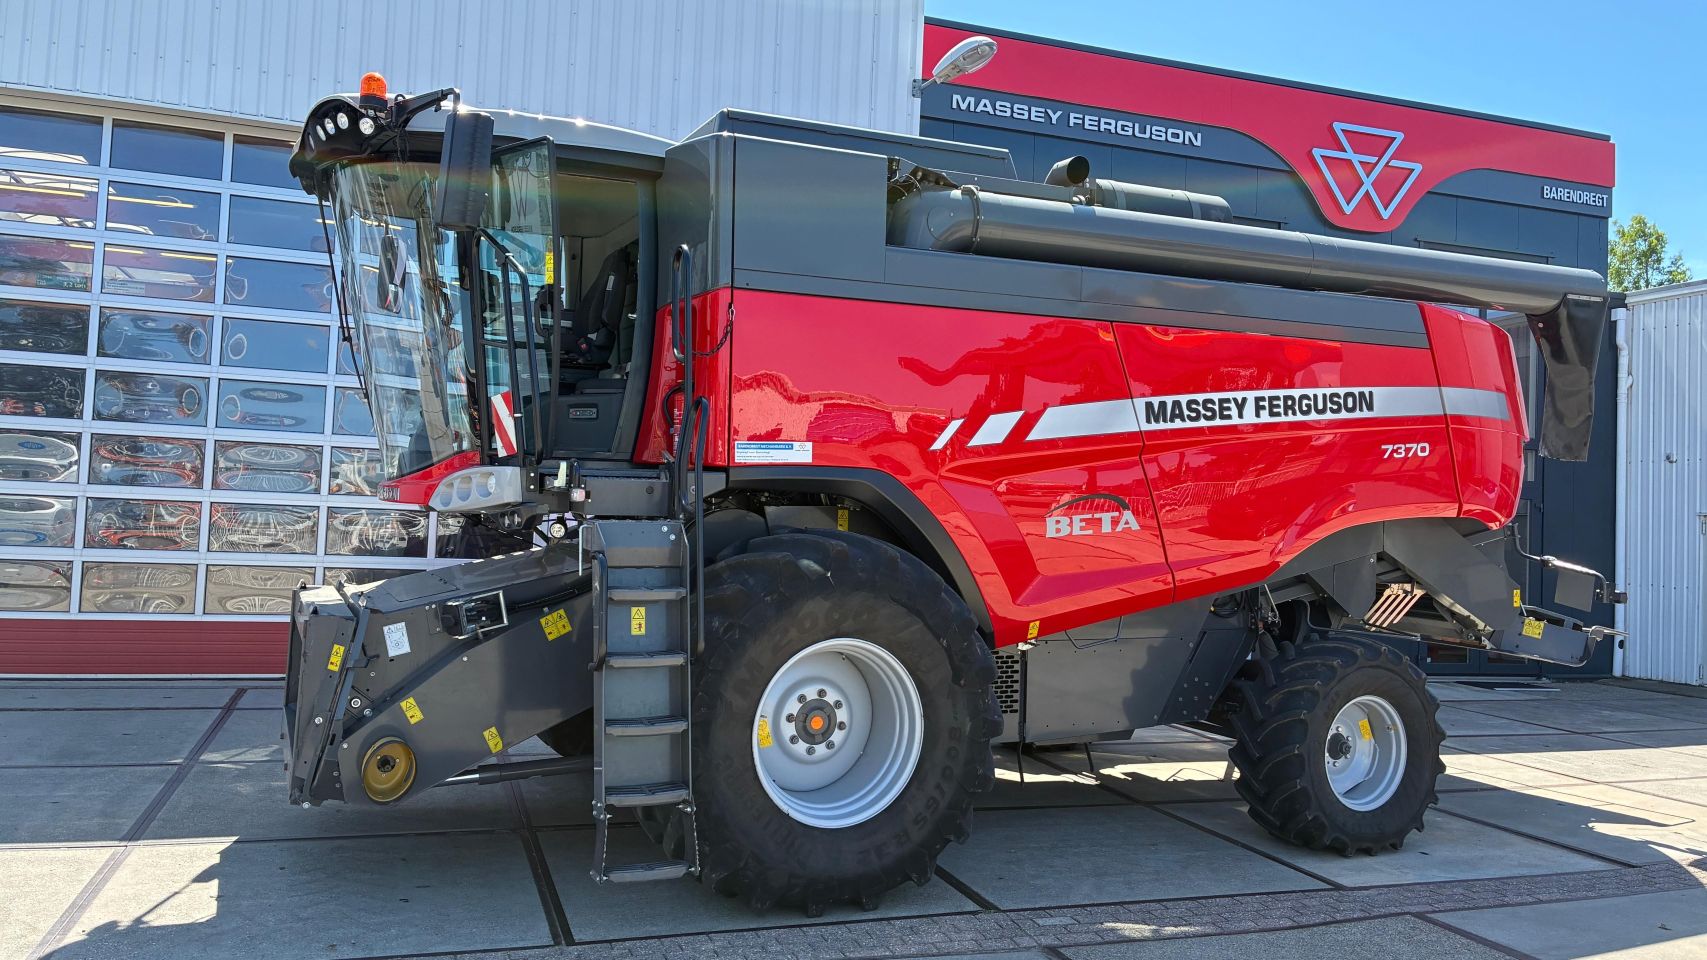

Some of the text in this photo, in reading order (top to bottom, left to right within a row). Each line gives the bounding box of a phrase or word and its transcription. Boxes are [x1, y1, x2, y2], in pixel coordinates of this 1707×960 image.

[952, 94, 1201, 146] MASSEY FERGUSON
[1543, 185, 1608, 207] BARENDREGT
[1145, 391, 1374, 424] MASSEY FERGUSON
[1381, 443, 1429, 459] 7370
[1046, 511, 1140, 538] BETA
